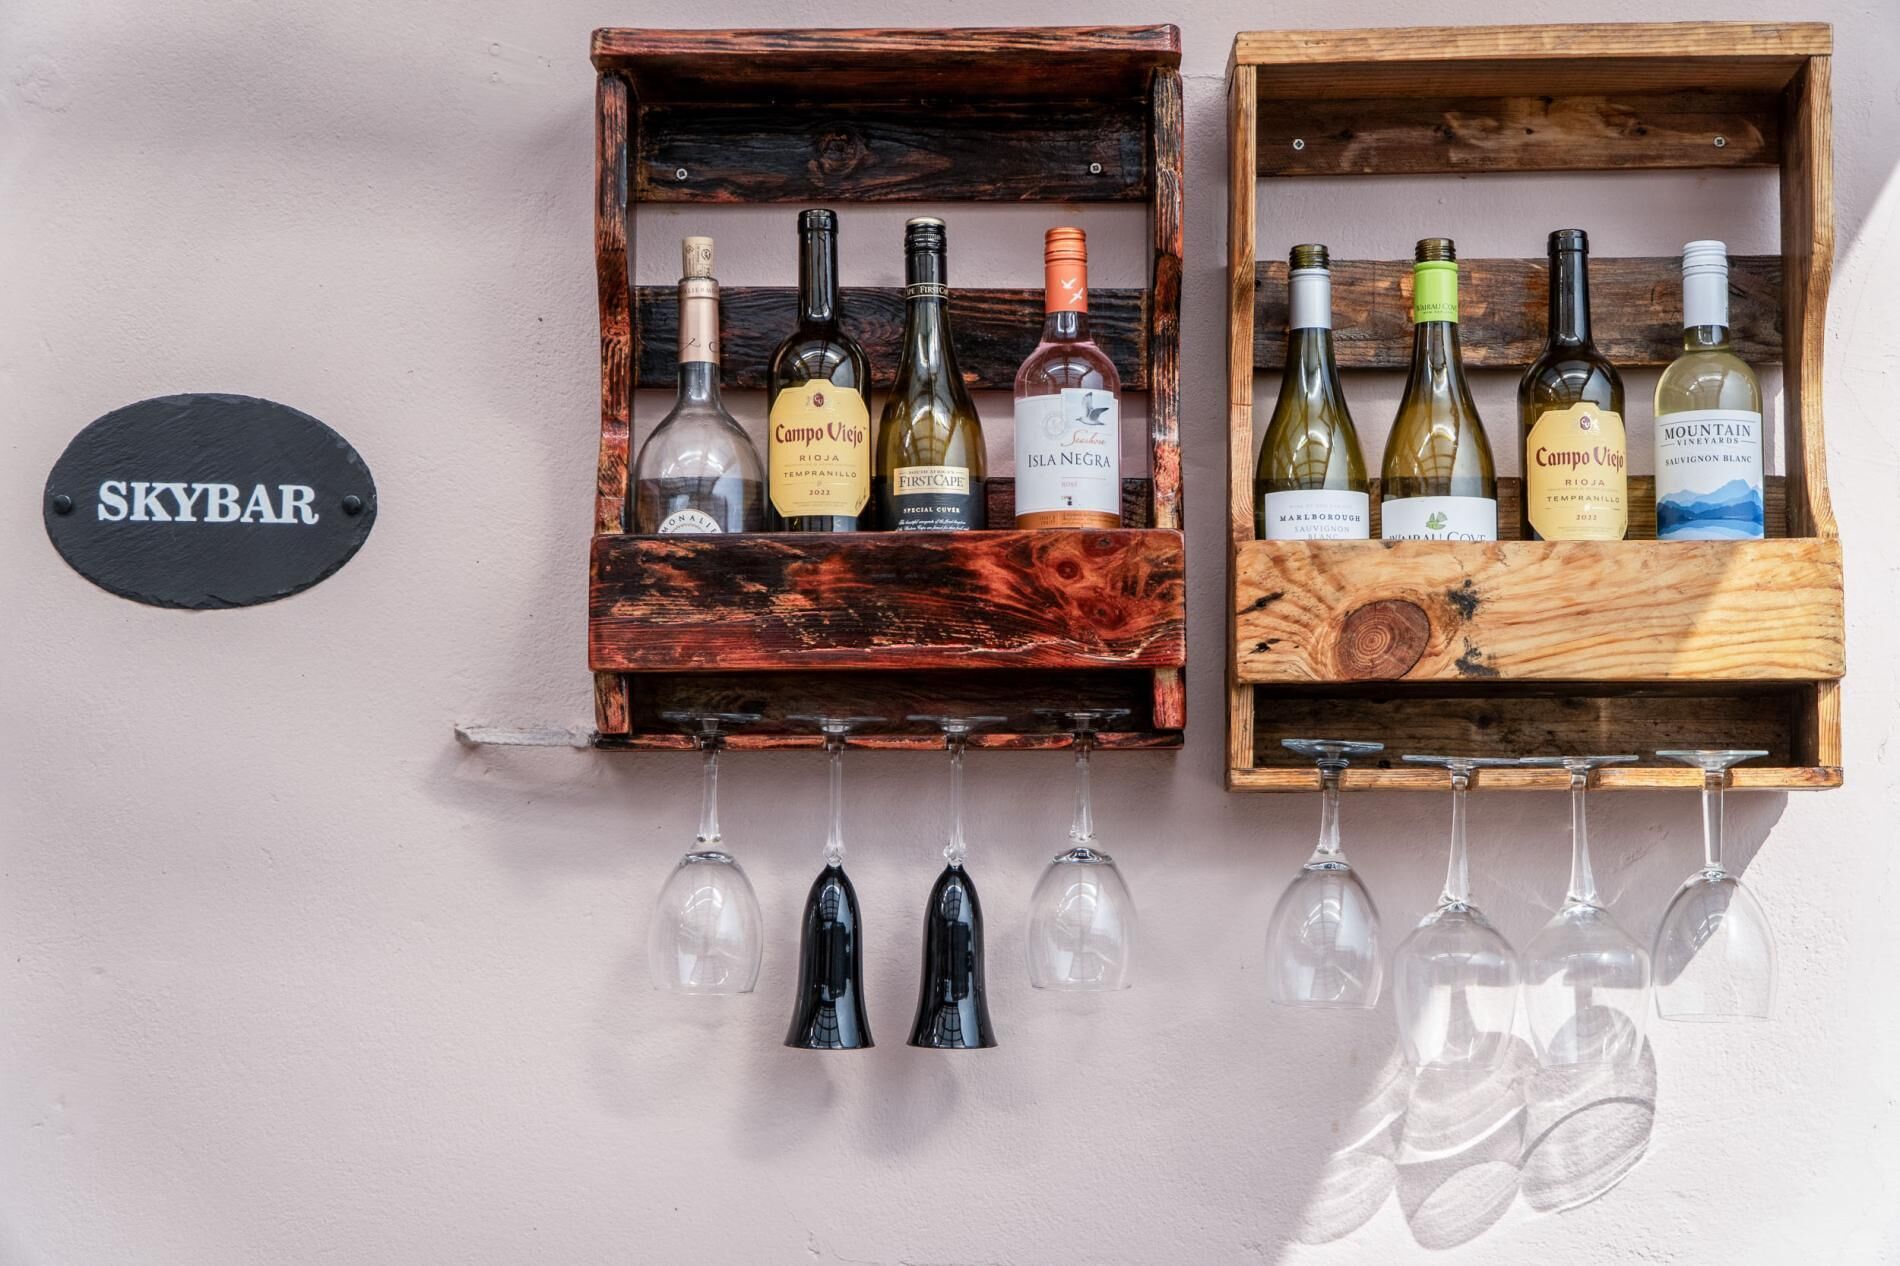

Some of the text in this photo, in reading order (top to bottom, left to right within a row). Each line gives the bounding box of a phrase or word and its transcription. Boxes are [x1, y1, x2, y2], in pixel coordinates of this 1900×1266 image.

[775, 421, 864, 448] Campo Viejo
[1664, 423, 1752, 440] MOUNTAIN
[1677, 437, 1740, 446] VINEYARDS
[799, 454, 841, 462] RIOJA
[1028, 451, 1112, 468] ISLA NEGRA
[1535, 446, 1625, 473] Campo Viejo
[1664, 454, 1752, 466] SAUVIGNON BLANC
[783, 470, 858, 479] TEMPRANILLO
[899, 474, 964, 487] FIRSTCAPE
[1565, 478, 1606, 487] RIOJA
[809, 489, 831, 497] 2022
[97, 480, 320, 525] SKYBAR
[1546, 495, 1621, 503] TEMPRANILLO
[903, 506, 934, 514] SPECIAL
[1280, 513, 1361, 523] MARLBOROUGH
[1294, 524, 1351, 533] SAUVIGNON
